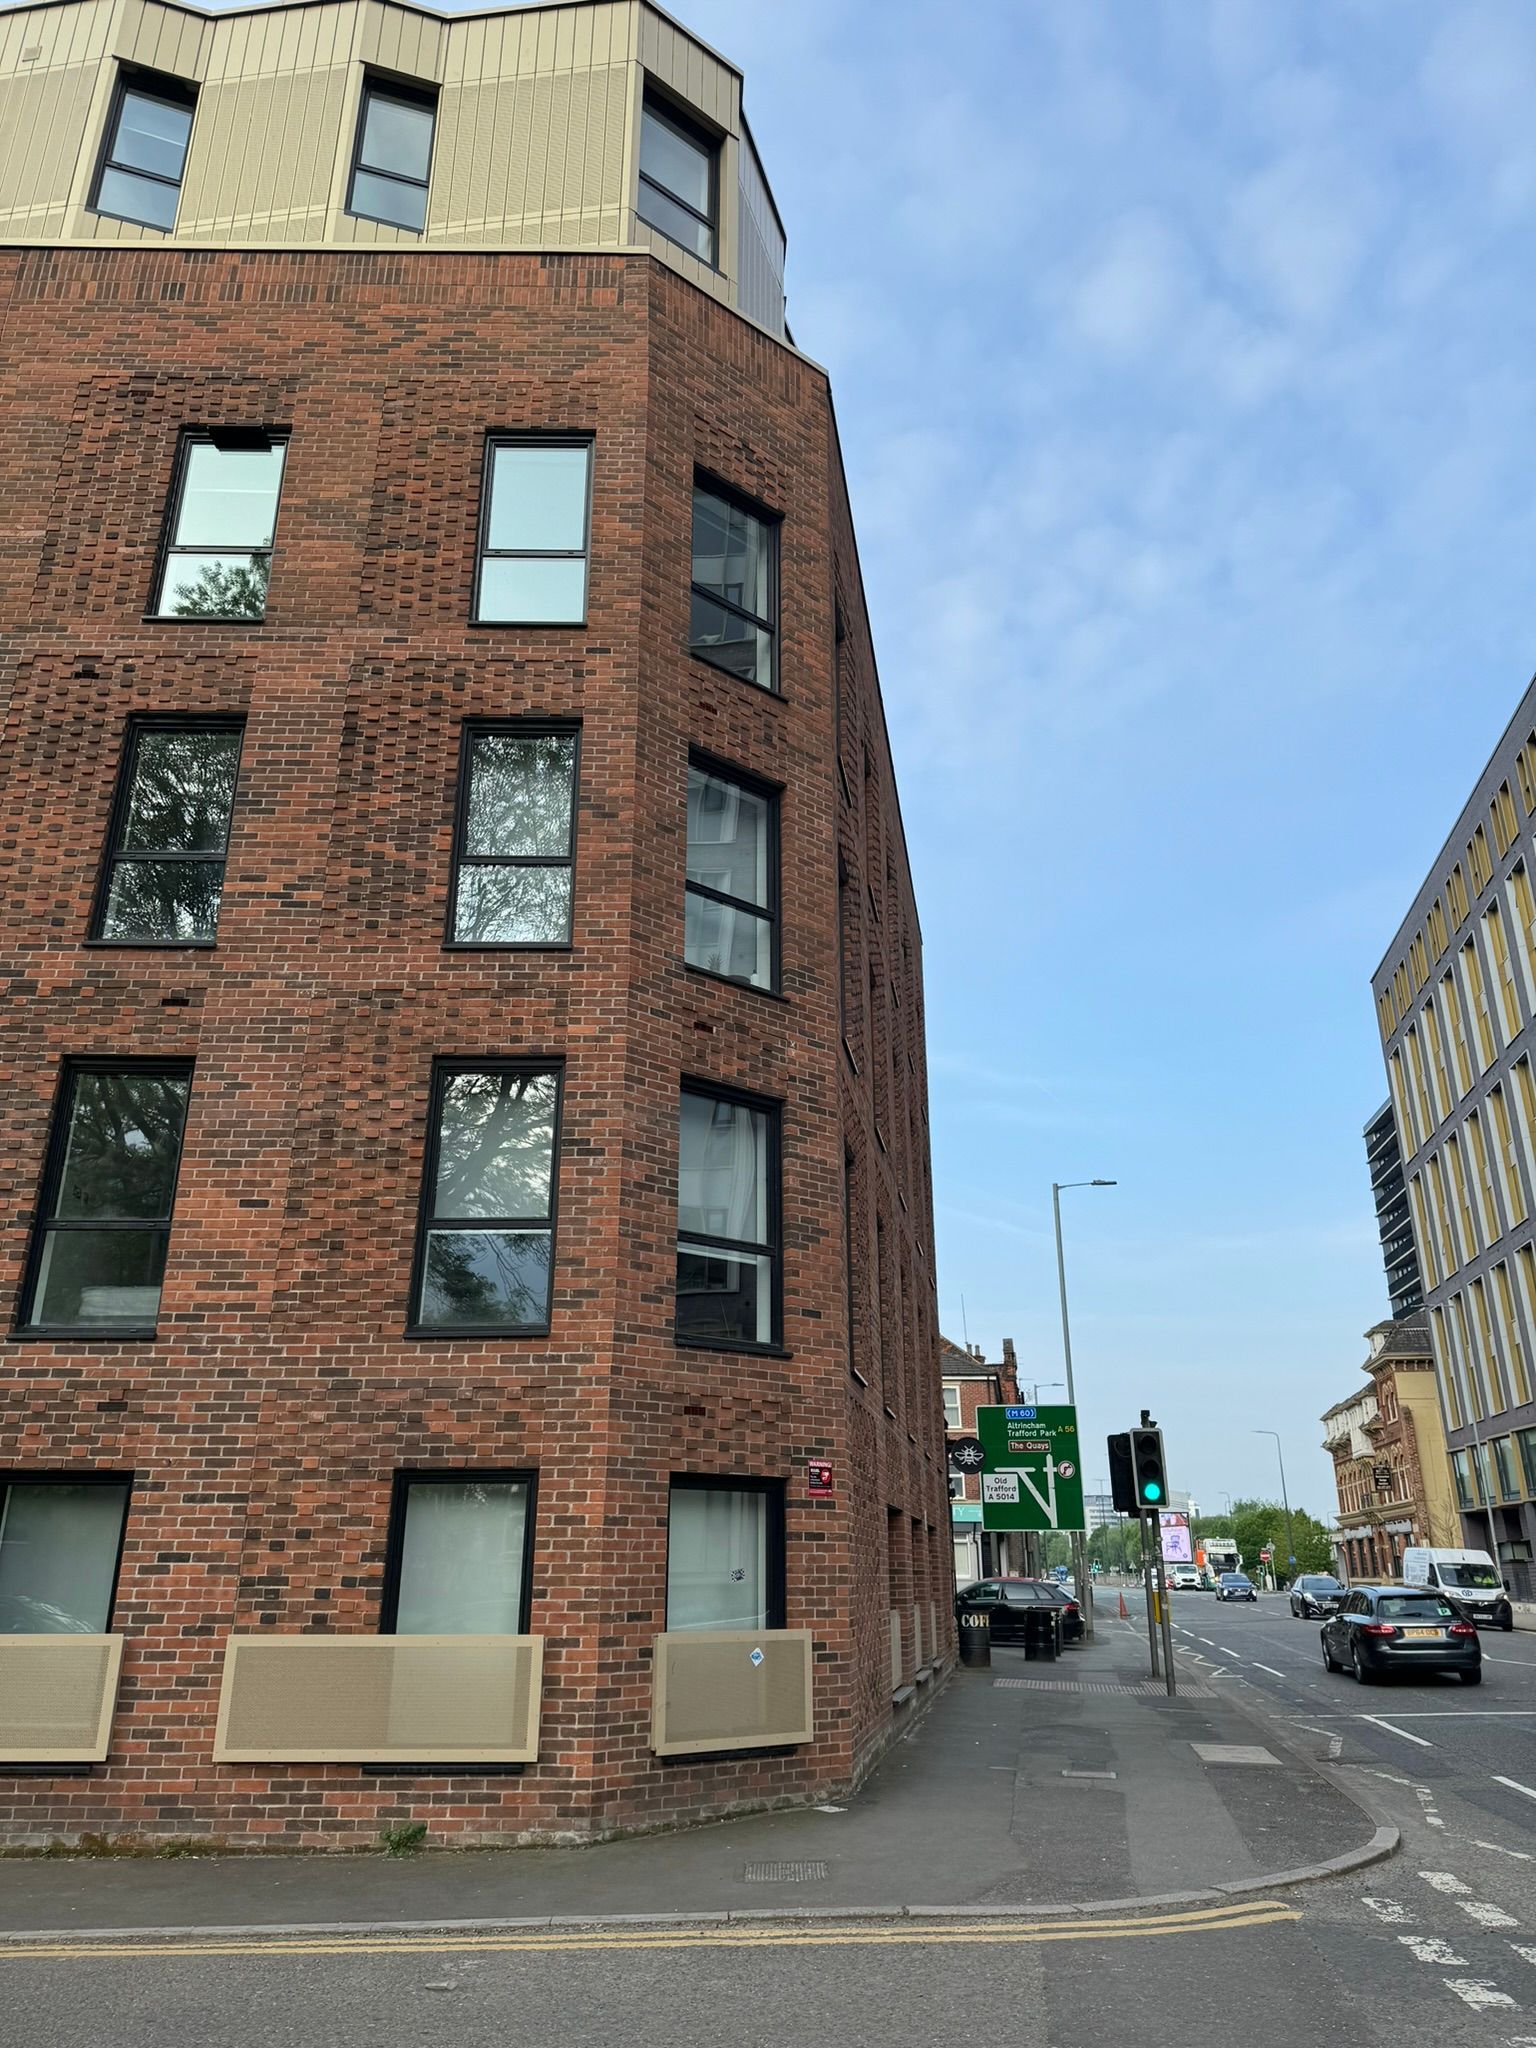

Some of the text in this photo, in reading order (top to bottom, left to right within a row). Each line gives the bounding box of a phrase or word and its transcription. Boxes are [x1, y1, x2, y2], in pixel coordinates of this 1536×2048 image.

[1007, 1409, 1034, 1417] (M 60)
[1026, 1442, 1049, 1450] Quays
